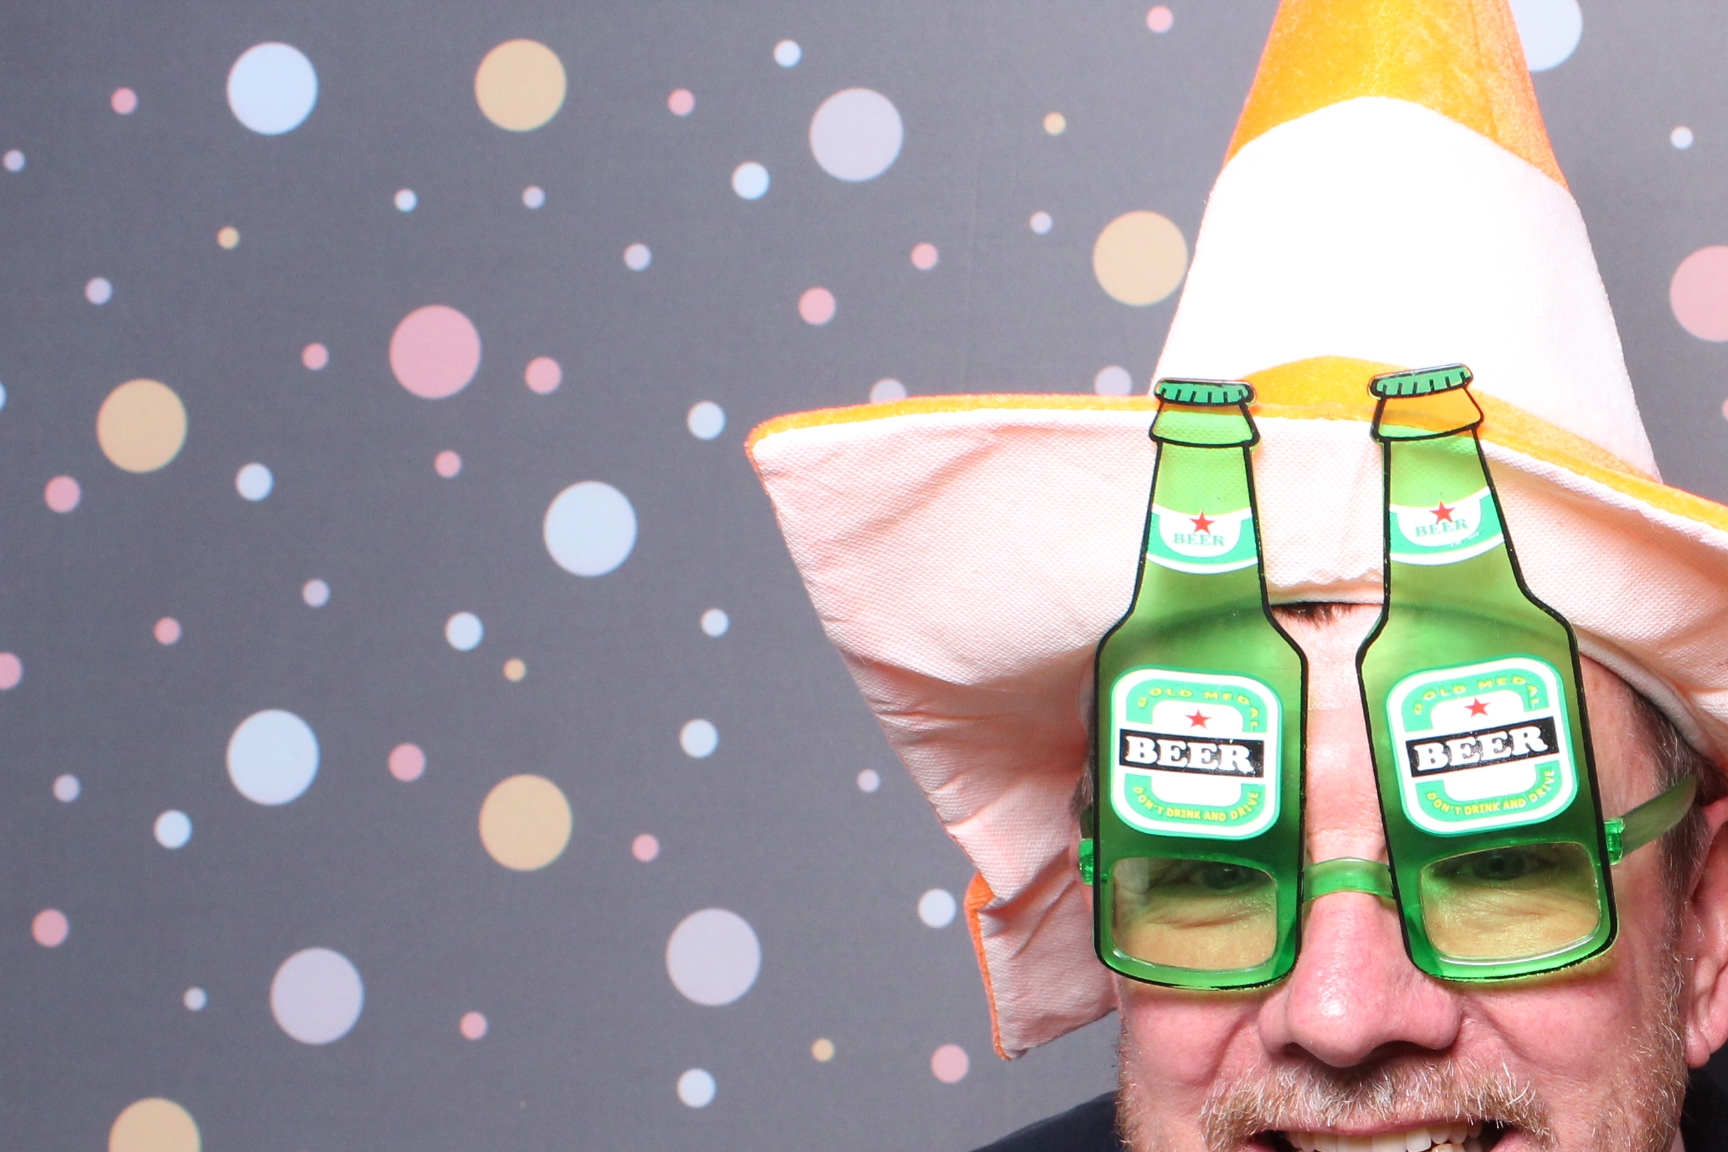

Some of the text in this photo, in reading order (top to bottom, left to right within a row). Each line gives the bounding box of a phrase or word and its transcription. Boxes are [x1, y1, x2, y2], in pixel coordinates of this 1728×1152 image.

[1173, 532, 1225, 546] BEER
[1414, 518, 1469, 537] BEER
[1137, 687, 1260, 730] GOLD MEDAL
[1413, 675, 1540, 715] GOLD MEDAL
[1125, 735, 1255, 773] BEER
[1413, 725, 1549, 772] BEER
[1133, 786, 1259, 822] DON'T DRINK AND DRIVE
[1427, 769, 1555, 816] DON'T DRINK AND DRIVE
